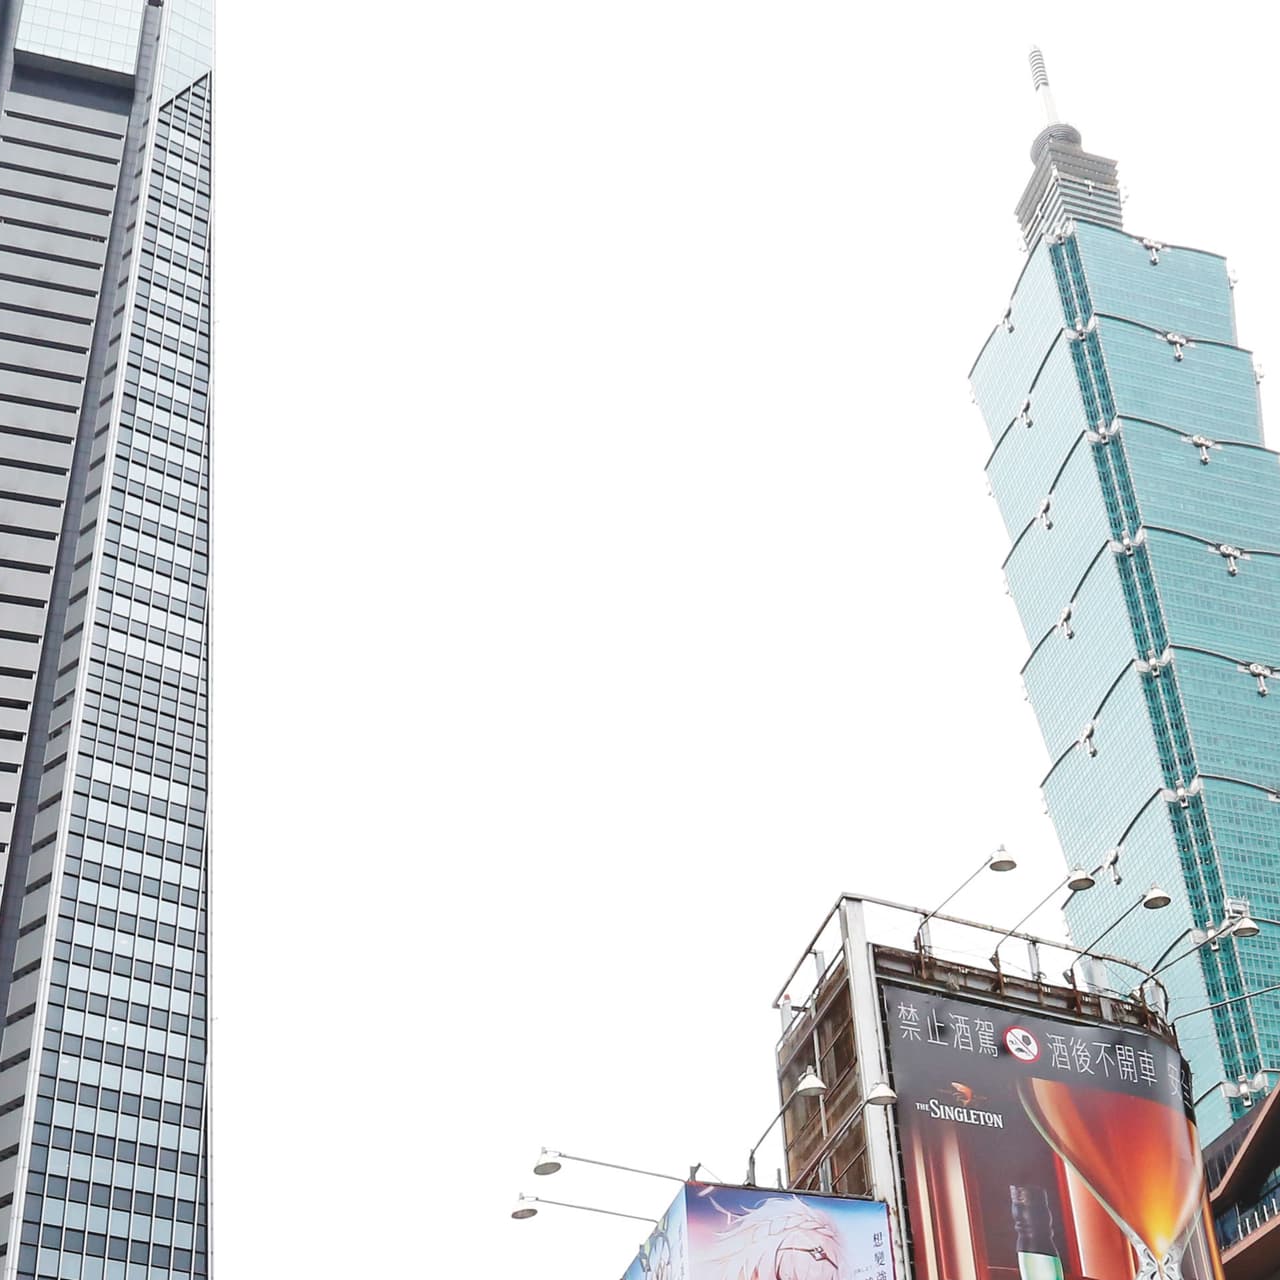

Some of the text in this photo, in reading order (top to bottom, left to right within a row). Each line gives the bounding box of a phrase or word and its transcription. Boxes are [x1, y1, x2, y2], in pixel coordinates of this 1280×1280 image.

[897, 1003, 999, 1058] 禁止酒駕
[1046, 1032, 1158, 1087] 酒後不開車
[915, 1099, 1004, 1129] THE SINGLETON
